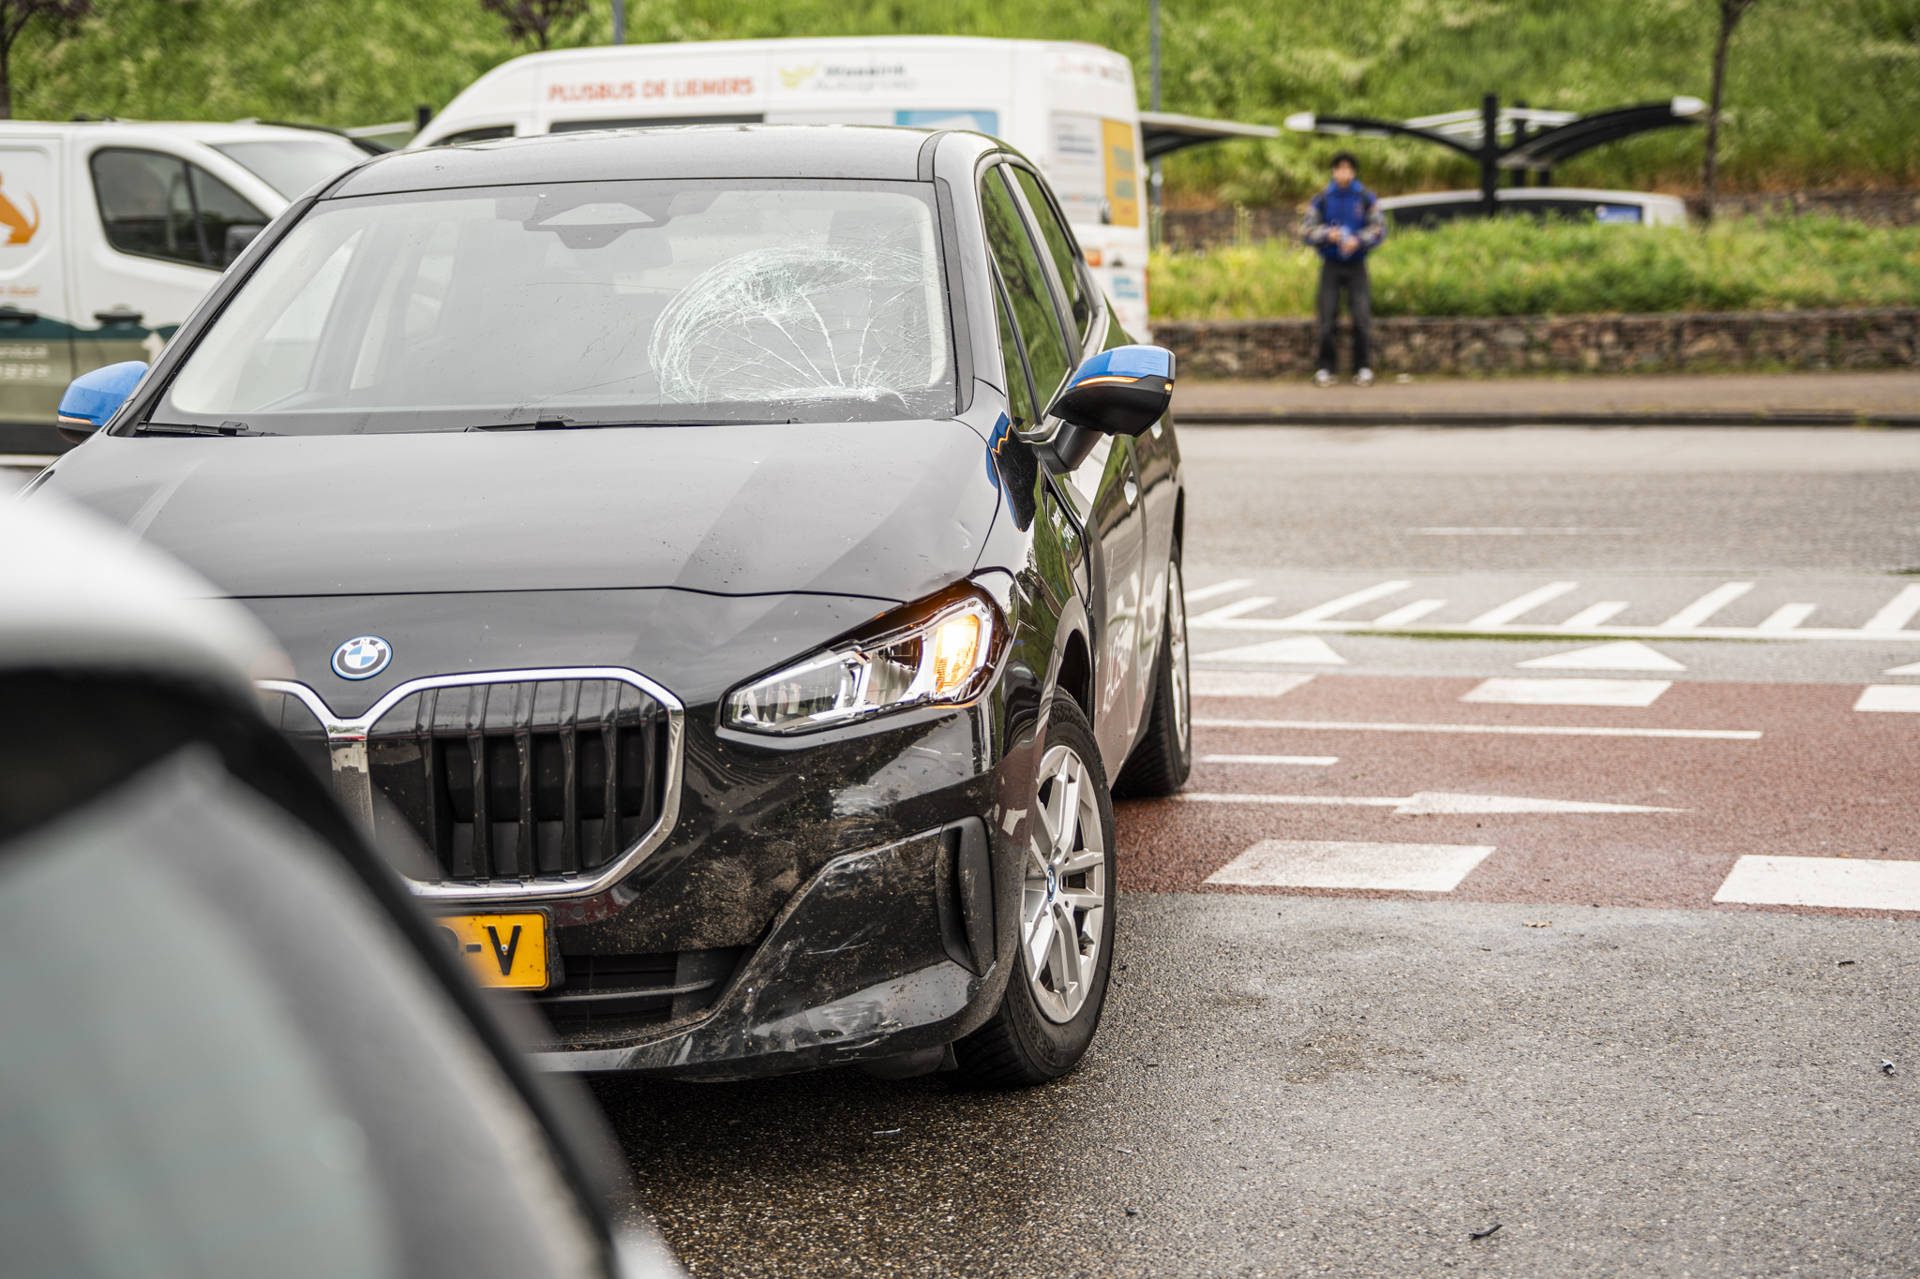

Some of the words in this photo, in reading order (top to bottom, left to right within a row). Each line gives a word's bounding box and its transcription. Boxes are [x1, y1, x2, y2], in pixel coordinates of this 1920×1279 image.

[549, 82, 636, 102] PLUSBUS
[642, 80, 665, 99] DE
[673, 77, 753, 98] LIEMERS
